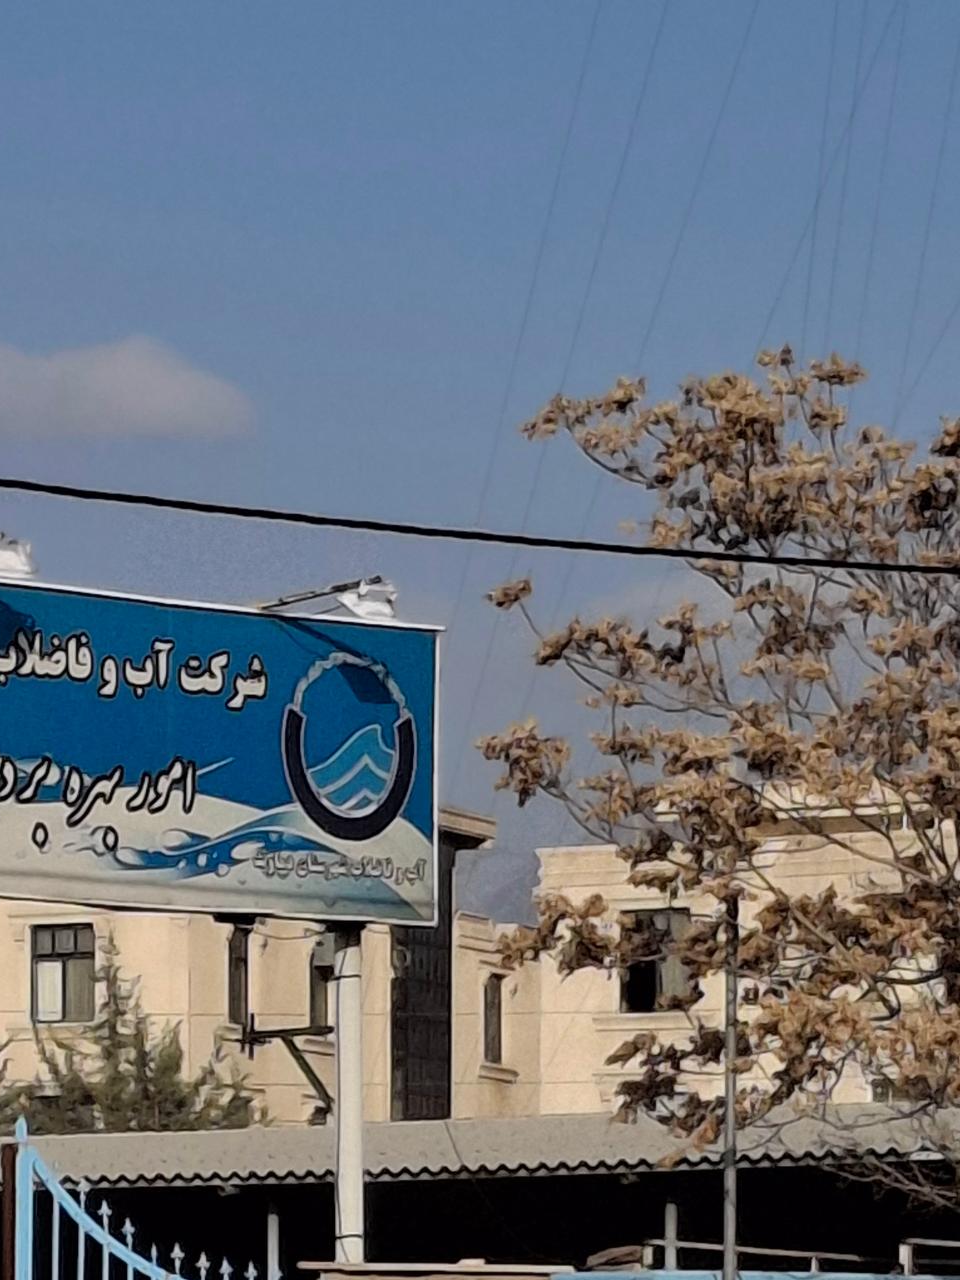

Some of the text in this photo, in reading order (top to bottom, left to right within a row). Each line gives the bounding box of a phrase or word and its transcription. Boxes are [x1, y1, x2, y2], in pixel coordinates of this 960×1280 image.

[97, 654, 119, 698] و
[123, 637, 176, 699] آب
[178, 650, 268, 711] شرکت
[63, 763, 124, 853] بهره
[126, 755, 196, 815] امور
